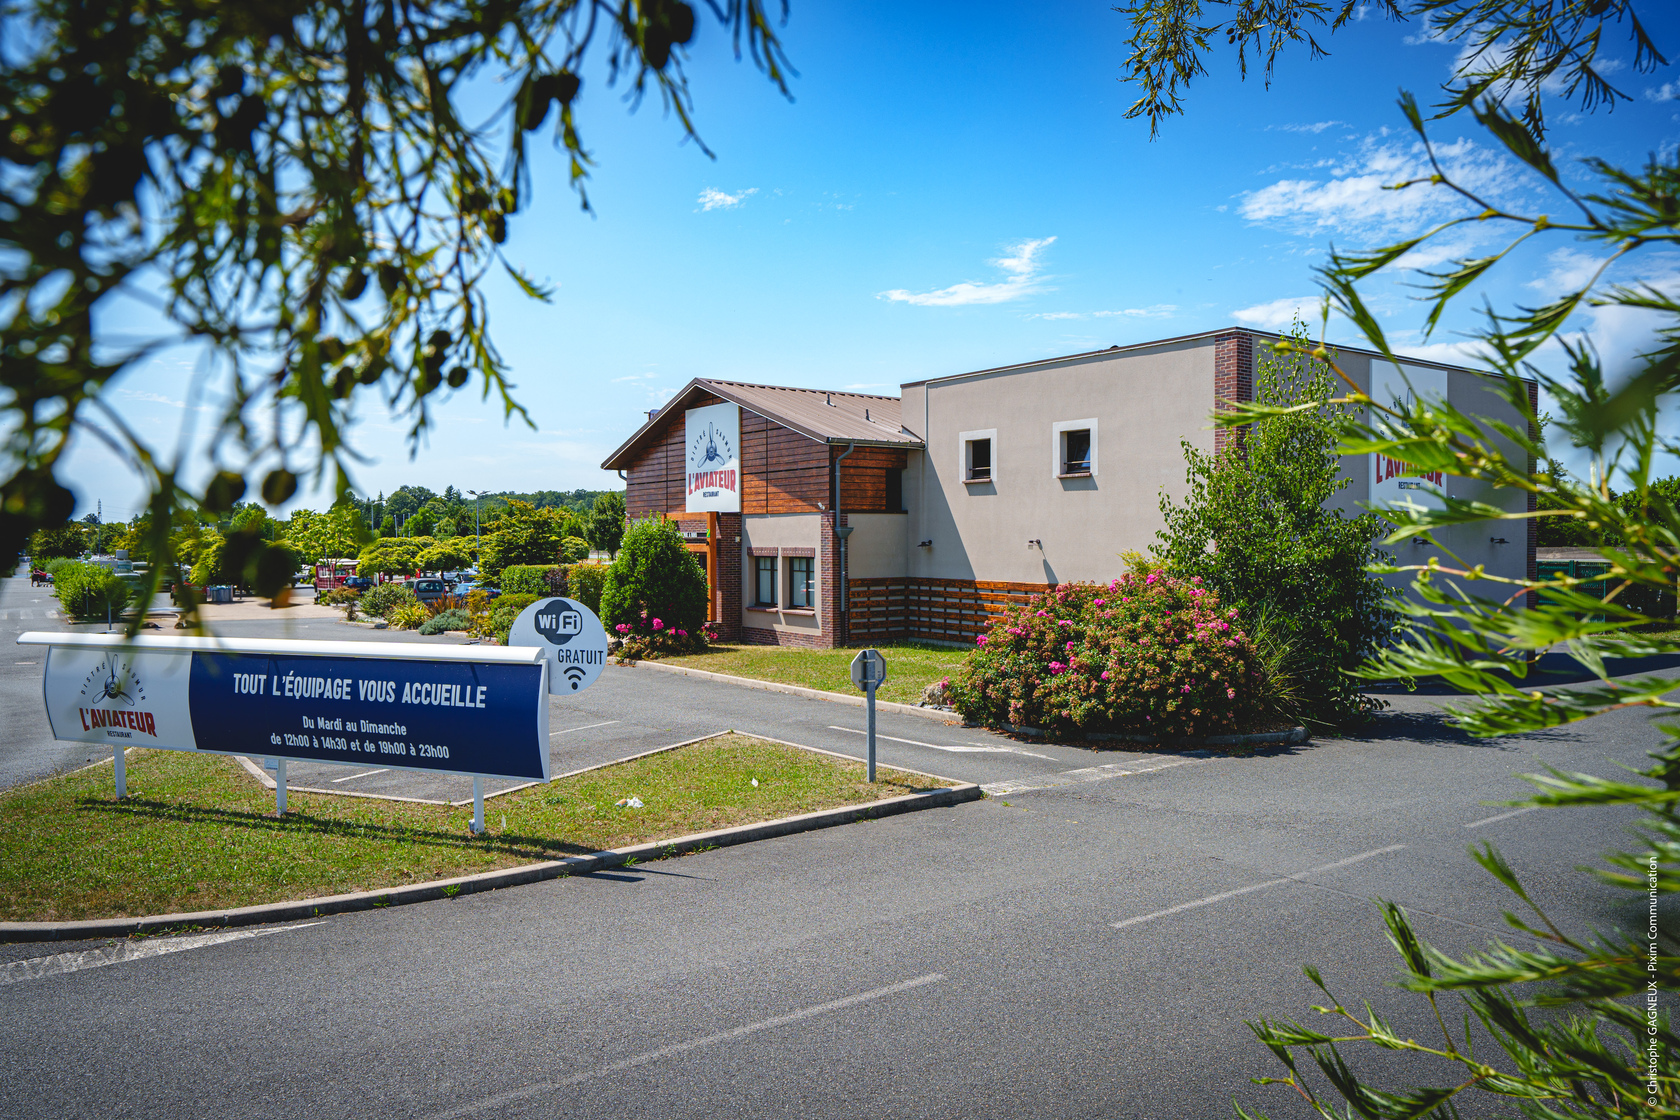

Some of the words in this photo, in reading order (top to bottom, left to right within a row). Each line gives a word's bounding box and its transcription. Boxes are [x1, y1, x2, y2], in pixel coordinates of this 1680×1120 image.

[688, 469, 736, 496] L'AVIATEUR
[557, 648, 604, 665] GRATUIT
[80, 660, 106, 696] DISTRÉ
[121, 663, 146, 701] SAUMUR
[233, 673, 267, 695] TOUT
[272, 670, 352, 700] L'ÉQUIPAGE
[358, 679, 396, 703] VOUS
[401, 682, 488, 709] ACCUEILLE
[78, 707, 158, 738] L'AVIATEUR
[106, 730, 133, 739] RESTAURANT
[302, 715, 315, 729] Du
[317, 716, 342, 731] Mardi
[345, 721, 358, 732] au
[360, 719, 407, 736] Dimanche
[270, 732, 282, 745] de
[283, 733, 310, 748] 12h00
[312, 735, 319, 748] à
[320, 736, 347, 751] 14h30
[350, 739, 362, 752] et
[363, 740, 376, 753] de
[378, 740, 406, 755] 19h00
[409, 742, 416, 756] à
[418, 743, 450, 759] 23h00
